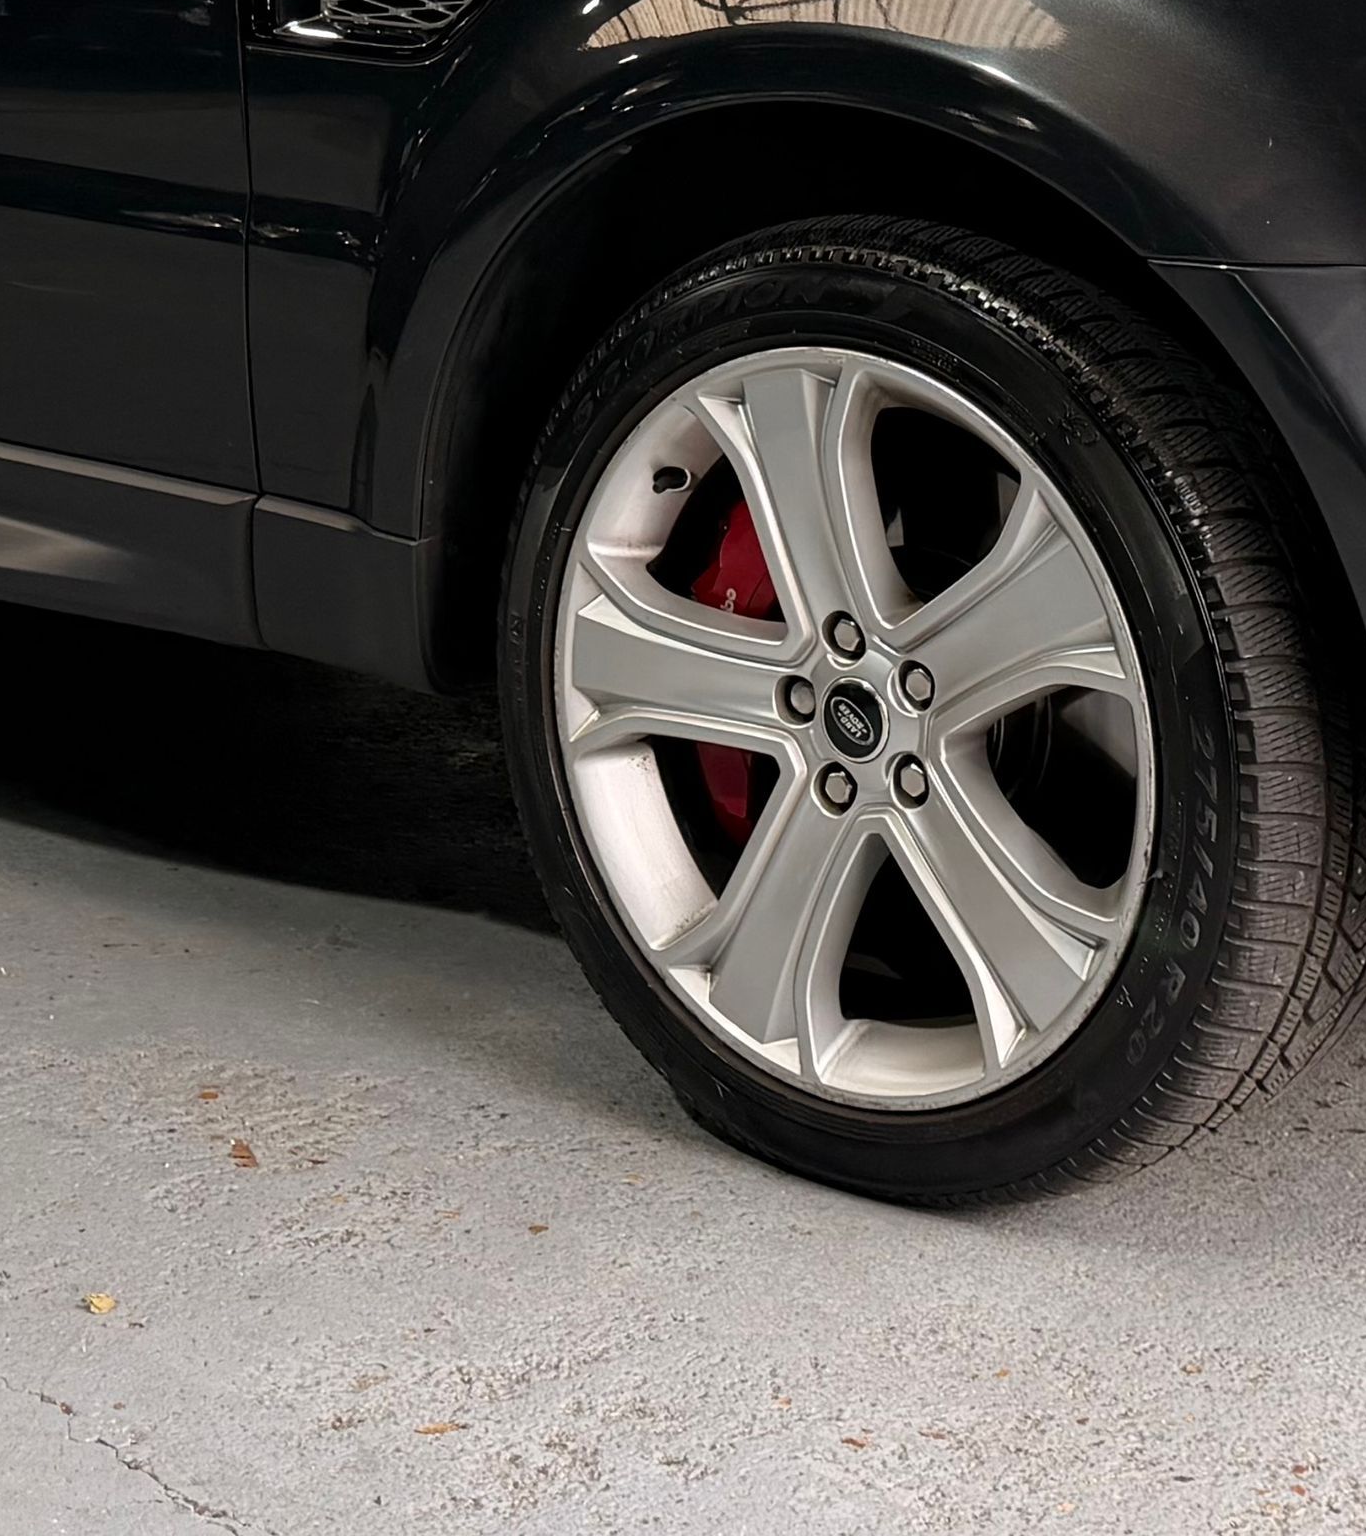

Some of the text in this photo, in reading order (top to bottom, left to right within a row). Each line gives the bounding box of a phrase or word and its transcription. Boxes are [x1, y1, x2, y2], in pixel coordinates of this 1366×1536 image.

[838, 703, 864, 730] ROVER
[840, 716, 862, 738] LAND
[1177, 714, 1218, 951] 275/40
